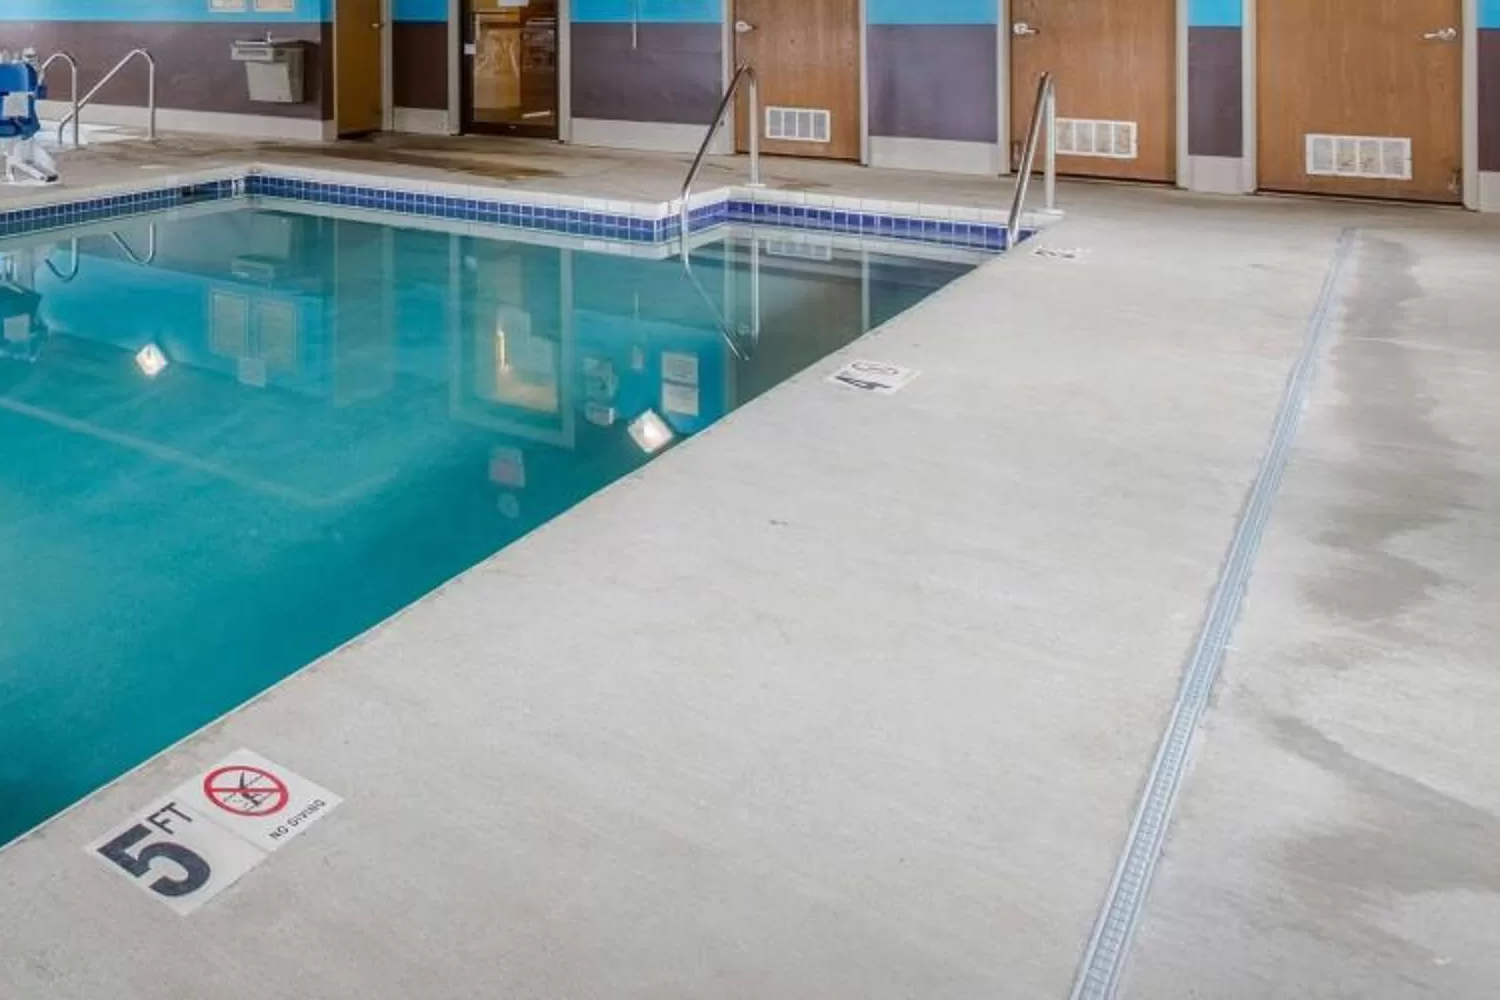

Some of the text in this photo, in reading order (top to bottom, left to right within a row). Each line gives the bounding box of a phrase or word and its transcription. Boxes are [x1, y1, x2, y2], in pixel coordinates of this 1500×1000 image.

[96, 801, 211, 897] 5 FT
[268, 799, 325, 840] NO DIVING
